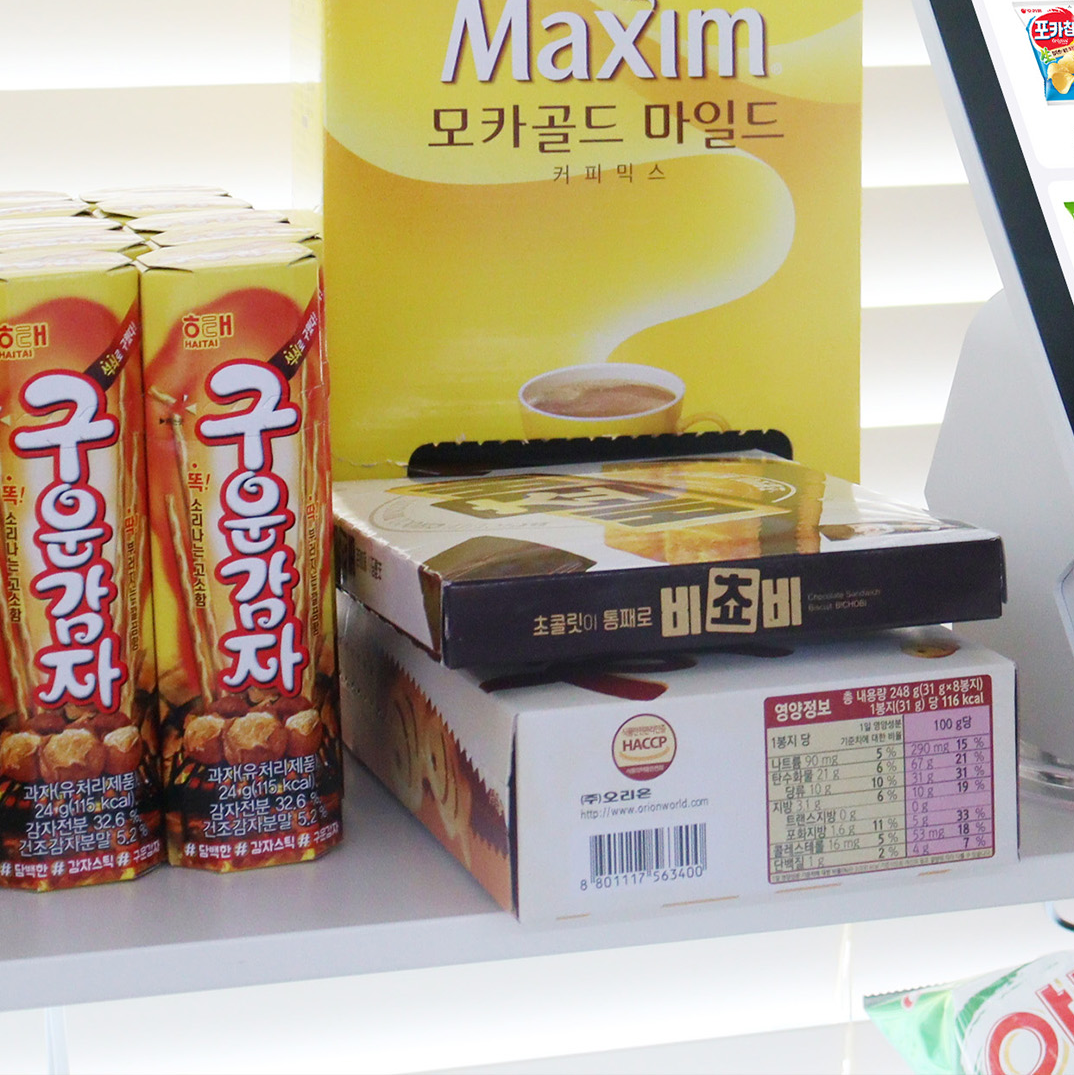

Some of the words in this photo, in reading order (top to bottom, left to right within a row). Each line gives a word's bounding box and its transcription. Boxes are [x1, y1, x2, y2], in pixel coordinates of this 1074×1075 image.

[427, 104, 625, 154] 모카골드
[643, 100, 785, 150] 마일드
[552, 162, 666, 185] 커피믹스
[184, 338, 220, 350] HAITAI
[187, 471, 211, 494] 똑!
[2, 484, 25, 506] 똑!
[199, 361, 303, 693] 구운감자
[13, 372, 122, 709] 구운감자
[533, 612, 598, 637] 초콜릿이
[602, 606, 653, 631] 통째로
[660, 567, 802, 638] 비쵸비
[856, 687, 887, 704] 내용량
[889, 685, 911, 699] 248
[942, 694, 959, 708] 116
[962, 692, 985, 706] kcal
[774, 698, 833, 723] 영양정보
[934, 718, 952, 730] 100
[622, 735, 668, 752] HACCP
[771, 734, 797, 750] 1봉지
[911, 742, 931, 756] 290
[956, 738, 968, 750] 15
[771, 756, 801, 773] 나트륨
[822, 755, 839, 767] mg
[955, 752, 967, 765] 21
[771, 769, 813, 786] 탄수화물
[955, 766, 967, 779] 31
[218, 784, 236, 800] 24
[242, 779, 277, 800] g(115
[282, 773, 316, 792] kcal)
[871, 776, 884, 788] 10
[957, 780, 969, 793] 19
[34, 802, 52, 819] 24
[60, 798, 95, 819] g(115
[100, 791, 136, 811] kcal)
[580, 787, 652, 806] (주)오리온
[209, 800, 271, 821] 감자전분
[274, 793, 307, 811] 32.6
[580, 797, 709, 820] http://www.orionworld.com
[773, 800, 793, 814] 지방
[956, 809, 969, 822] 33
[26, 817, 88, 841] 감자전분
[93, 810, 125, 828] 32.6
[203, 815, 292, 839] 건조감자분말
[298, 809, 318, 826] 5.2
[786, 810, 836, 827] 트랜스지방
[872, 819, 884, 831] 11
[786, 824, 827, 841] 포화지방
[958, 823, 970, 835] 18
[18, 832, 112, 857] 건조감자분말
[117, 827, 137, 844] 5.2
[198, 841, 232, 859] 담백한
[250, 837, 296, 855] 감자스틱
[774, 838, 825, 858] 콜레스테롤
[14, 862, 48, 879] 담백한
[68, 854, 115, 875] 감자스틱
[774, 857, 805, 873] 단백질
[580, 879, 588, 892] 8
